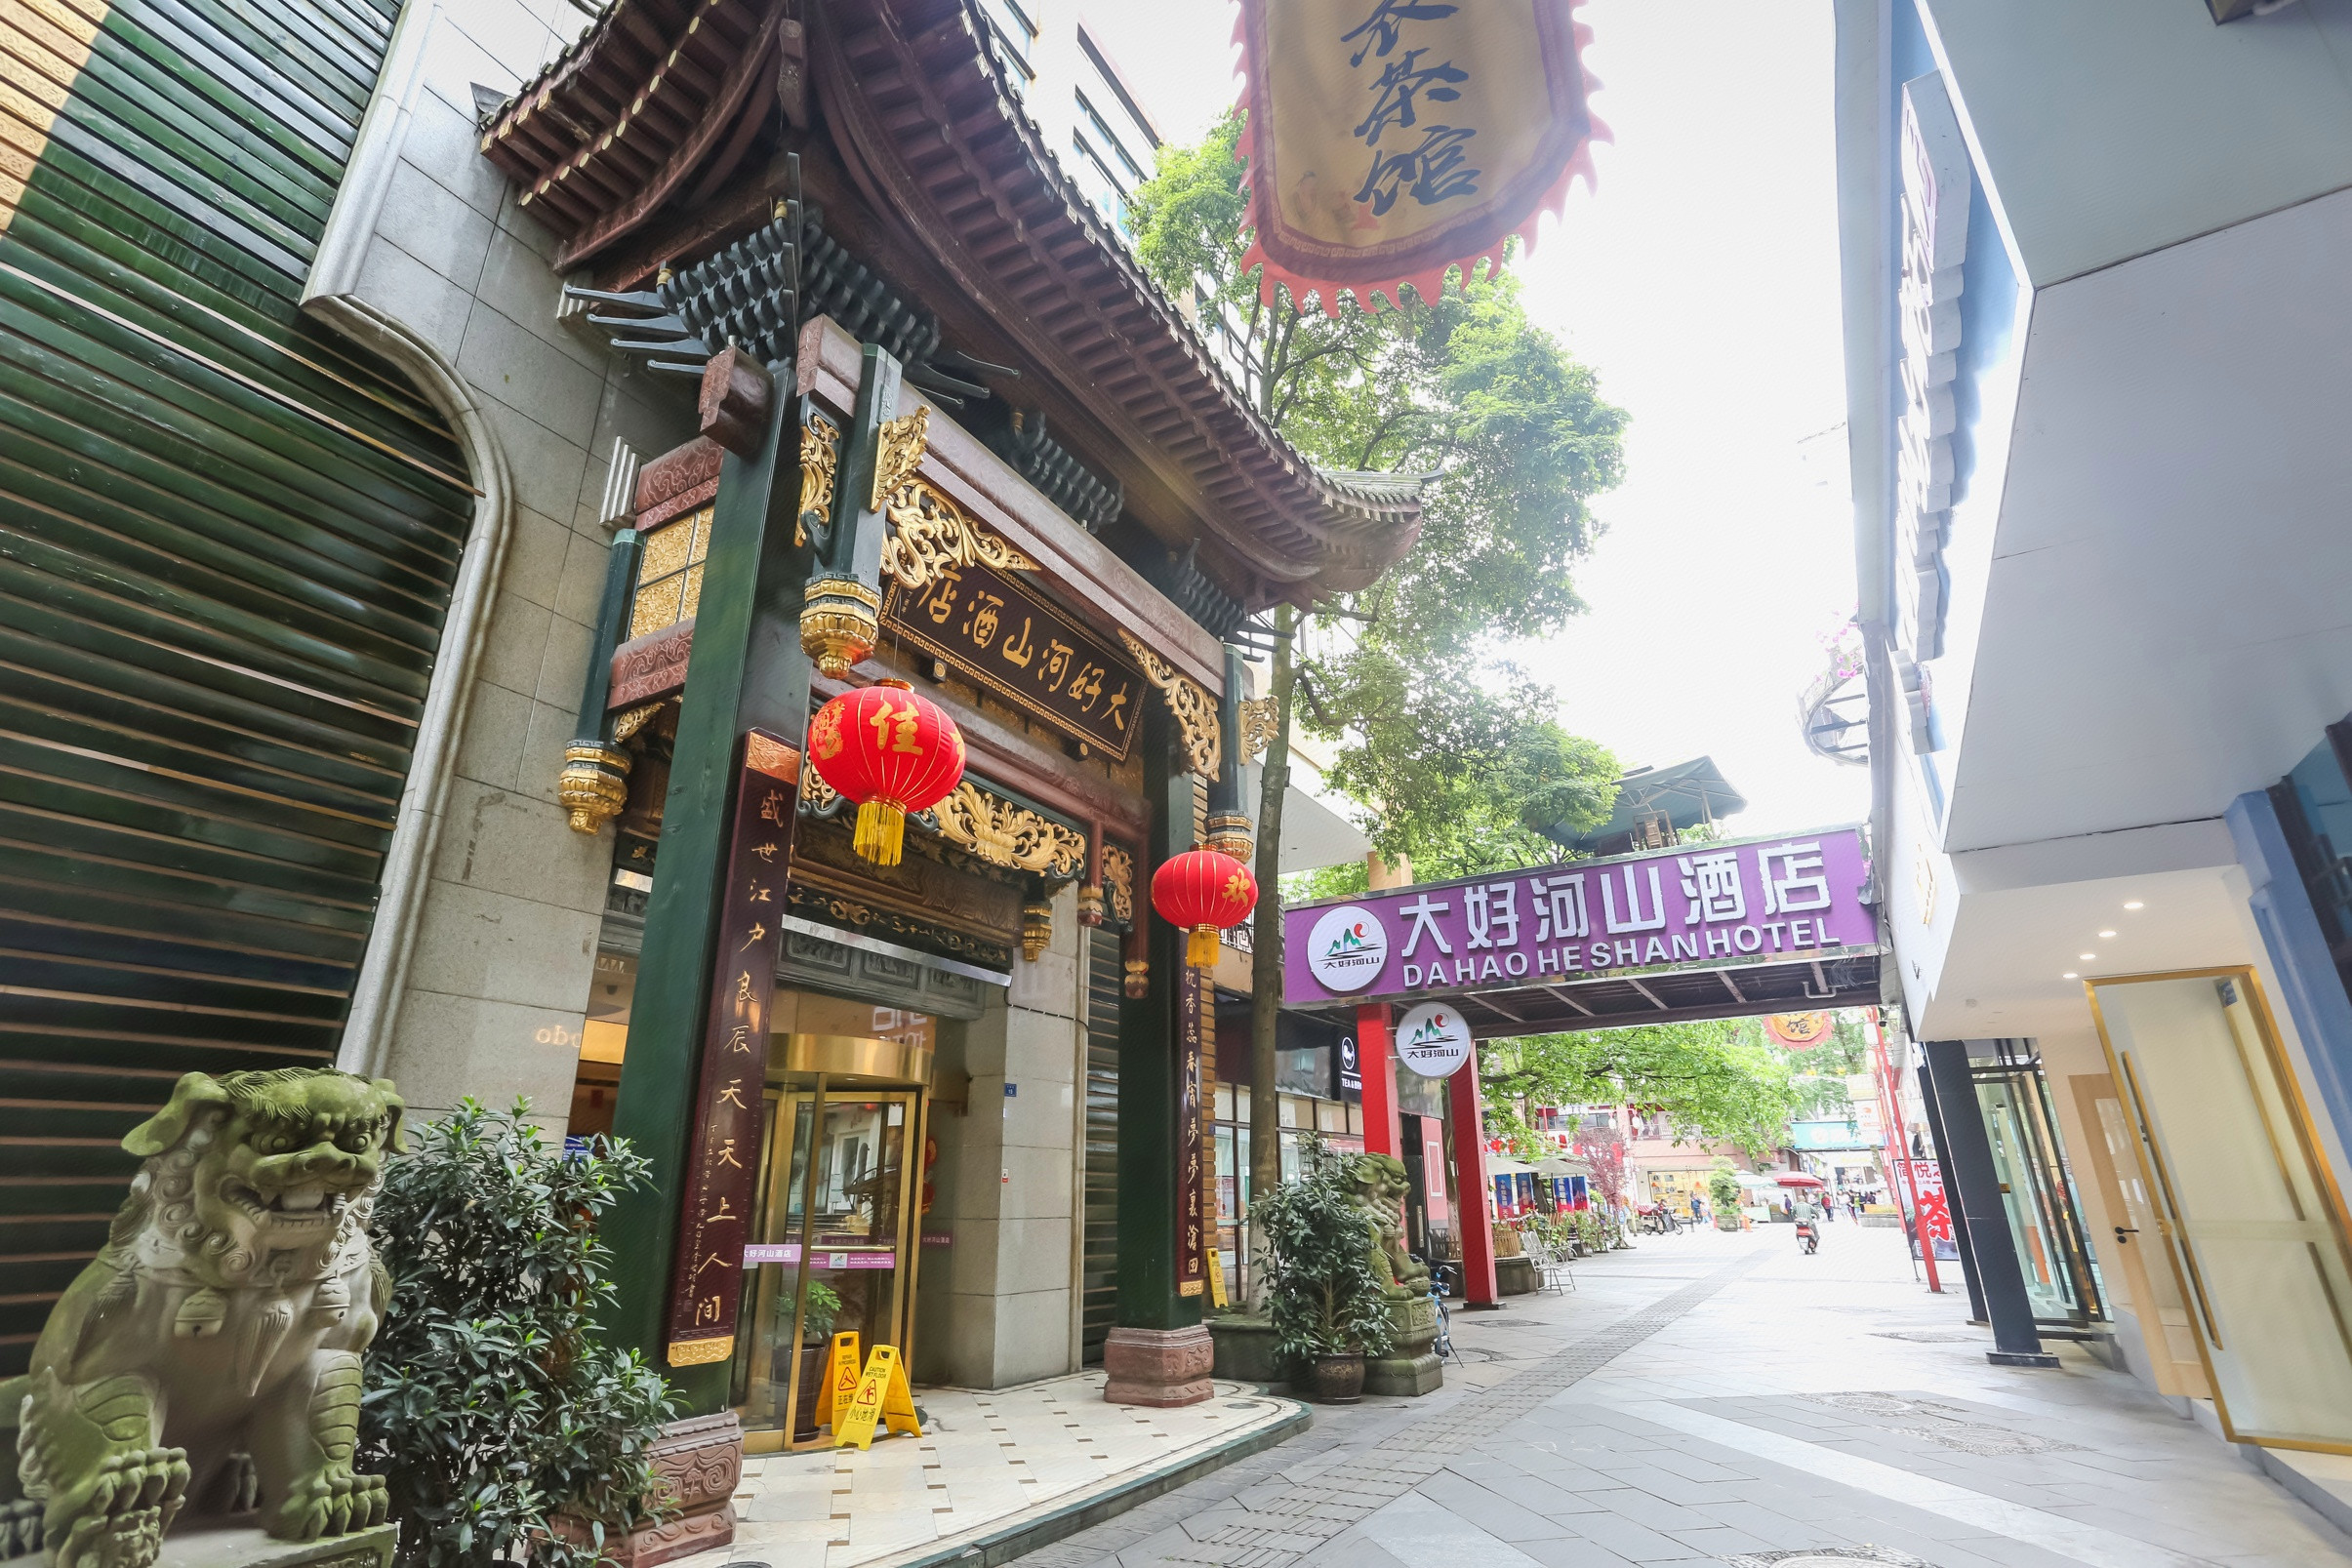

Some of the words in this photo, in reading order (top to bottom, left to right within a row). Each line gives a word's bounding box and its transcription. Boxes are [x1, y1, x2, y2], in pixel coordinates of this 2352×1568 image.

[870, 700, 924, 756] 佳
[1399, 841, 1832, 957] 大好河山酒店
[1323, 956, 1380, 970] 大好河山
[1403, 961, 1448, 987] DA
[1455, 952, 1528, 982] HAO
[1537, 945, 1583, 973] HE
[1590, 933, 1700, 967] SHAN
[1705, 917, 1841, 956] HOTEL
[1406, 1048, 1459, 1060] 大好河山
